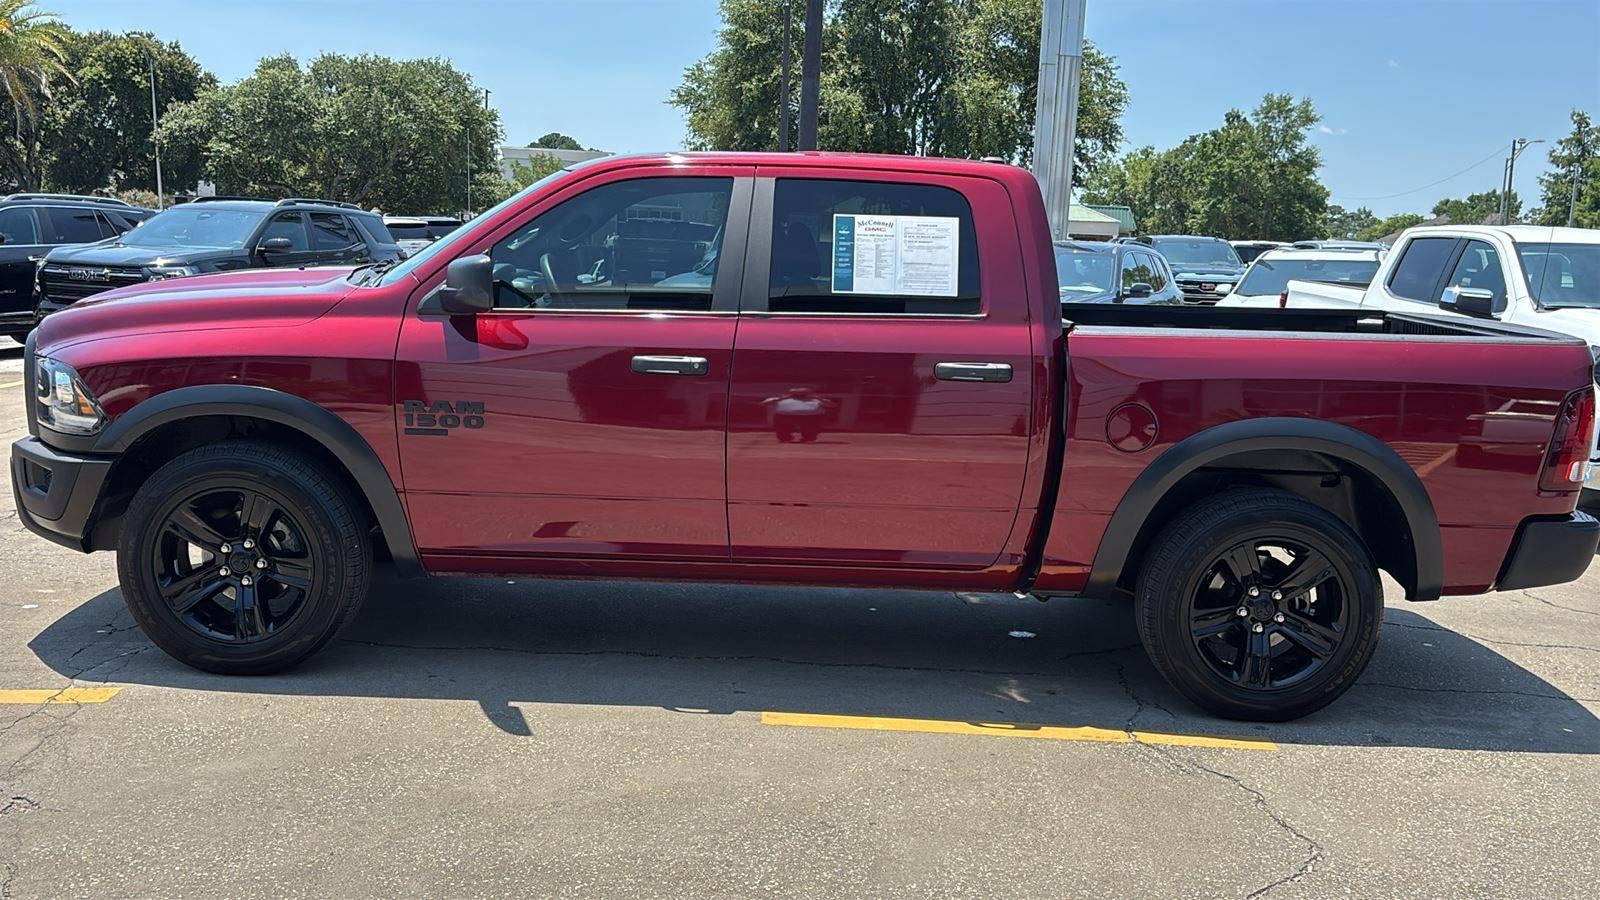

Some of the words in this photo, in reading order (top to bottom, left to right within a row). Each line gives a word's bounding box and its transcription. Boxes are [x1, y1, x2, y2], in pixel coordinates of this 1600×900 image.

[857, 219, 894, 228] McConnell
[69, 268, 109, 281] GMC
[403, 399, 485, 414] RAM
[404, 413, 485, 429] 1500
